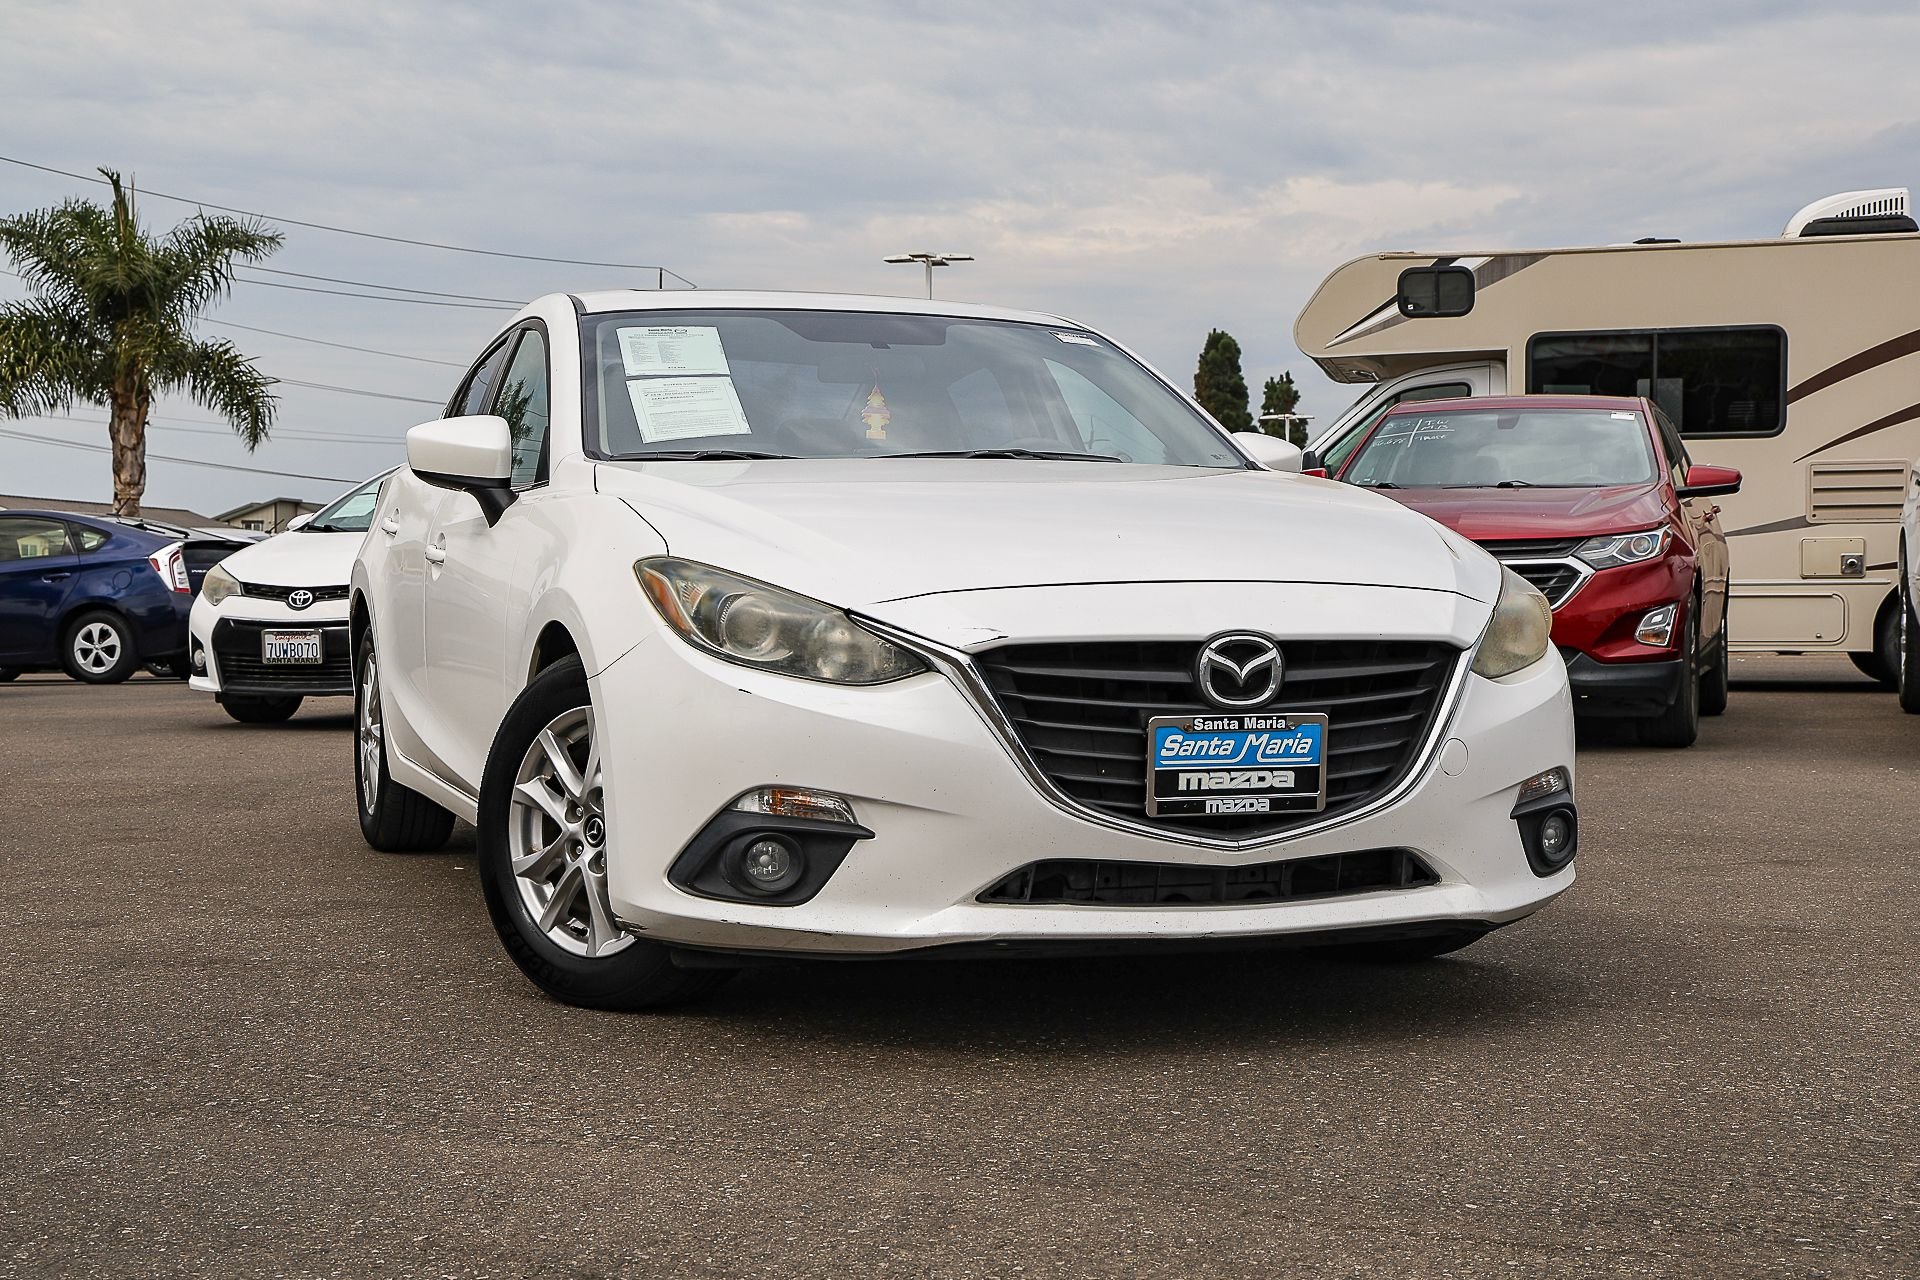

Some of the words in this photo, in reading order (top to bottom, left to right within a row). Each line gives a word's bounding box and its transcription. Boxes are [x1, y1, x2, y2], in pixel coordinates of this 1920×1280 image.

[266, 642, 319, 658] 7UWB070
[1193, 718, 1239, 731] Santa
[1244, 717, 1287, 730] Maria
[1160, 734, 1235, 757] Santa
[1239, 733, 1313, 762] Maria
[1178, 770, 1296, 791] mazda
[1205, 798, 1270, 814] mazda
